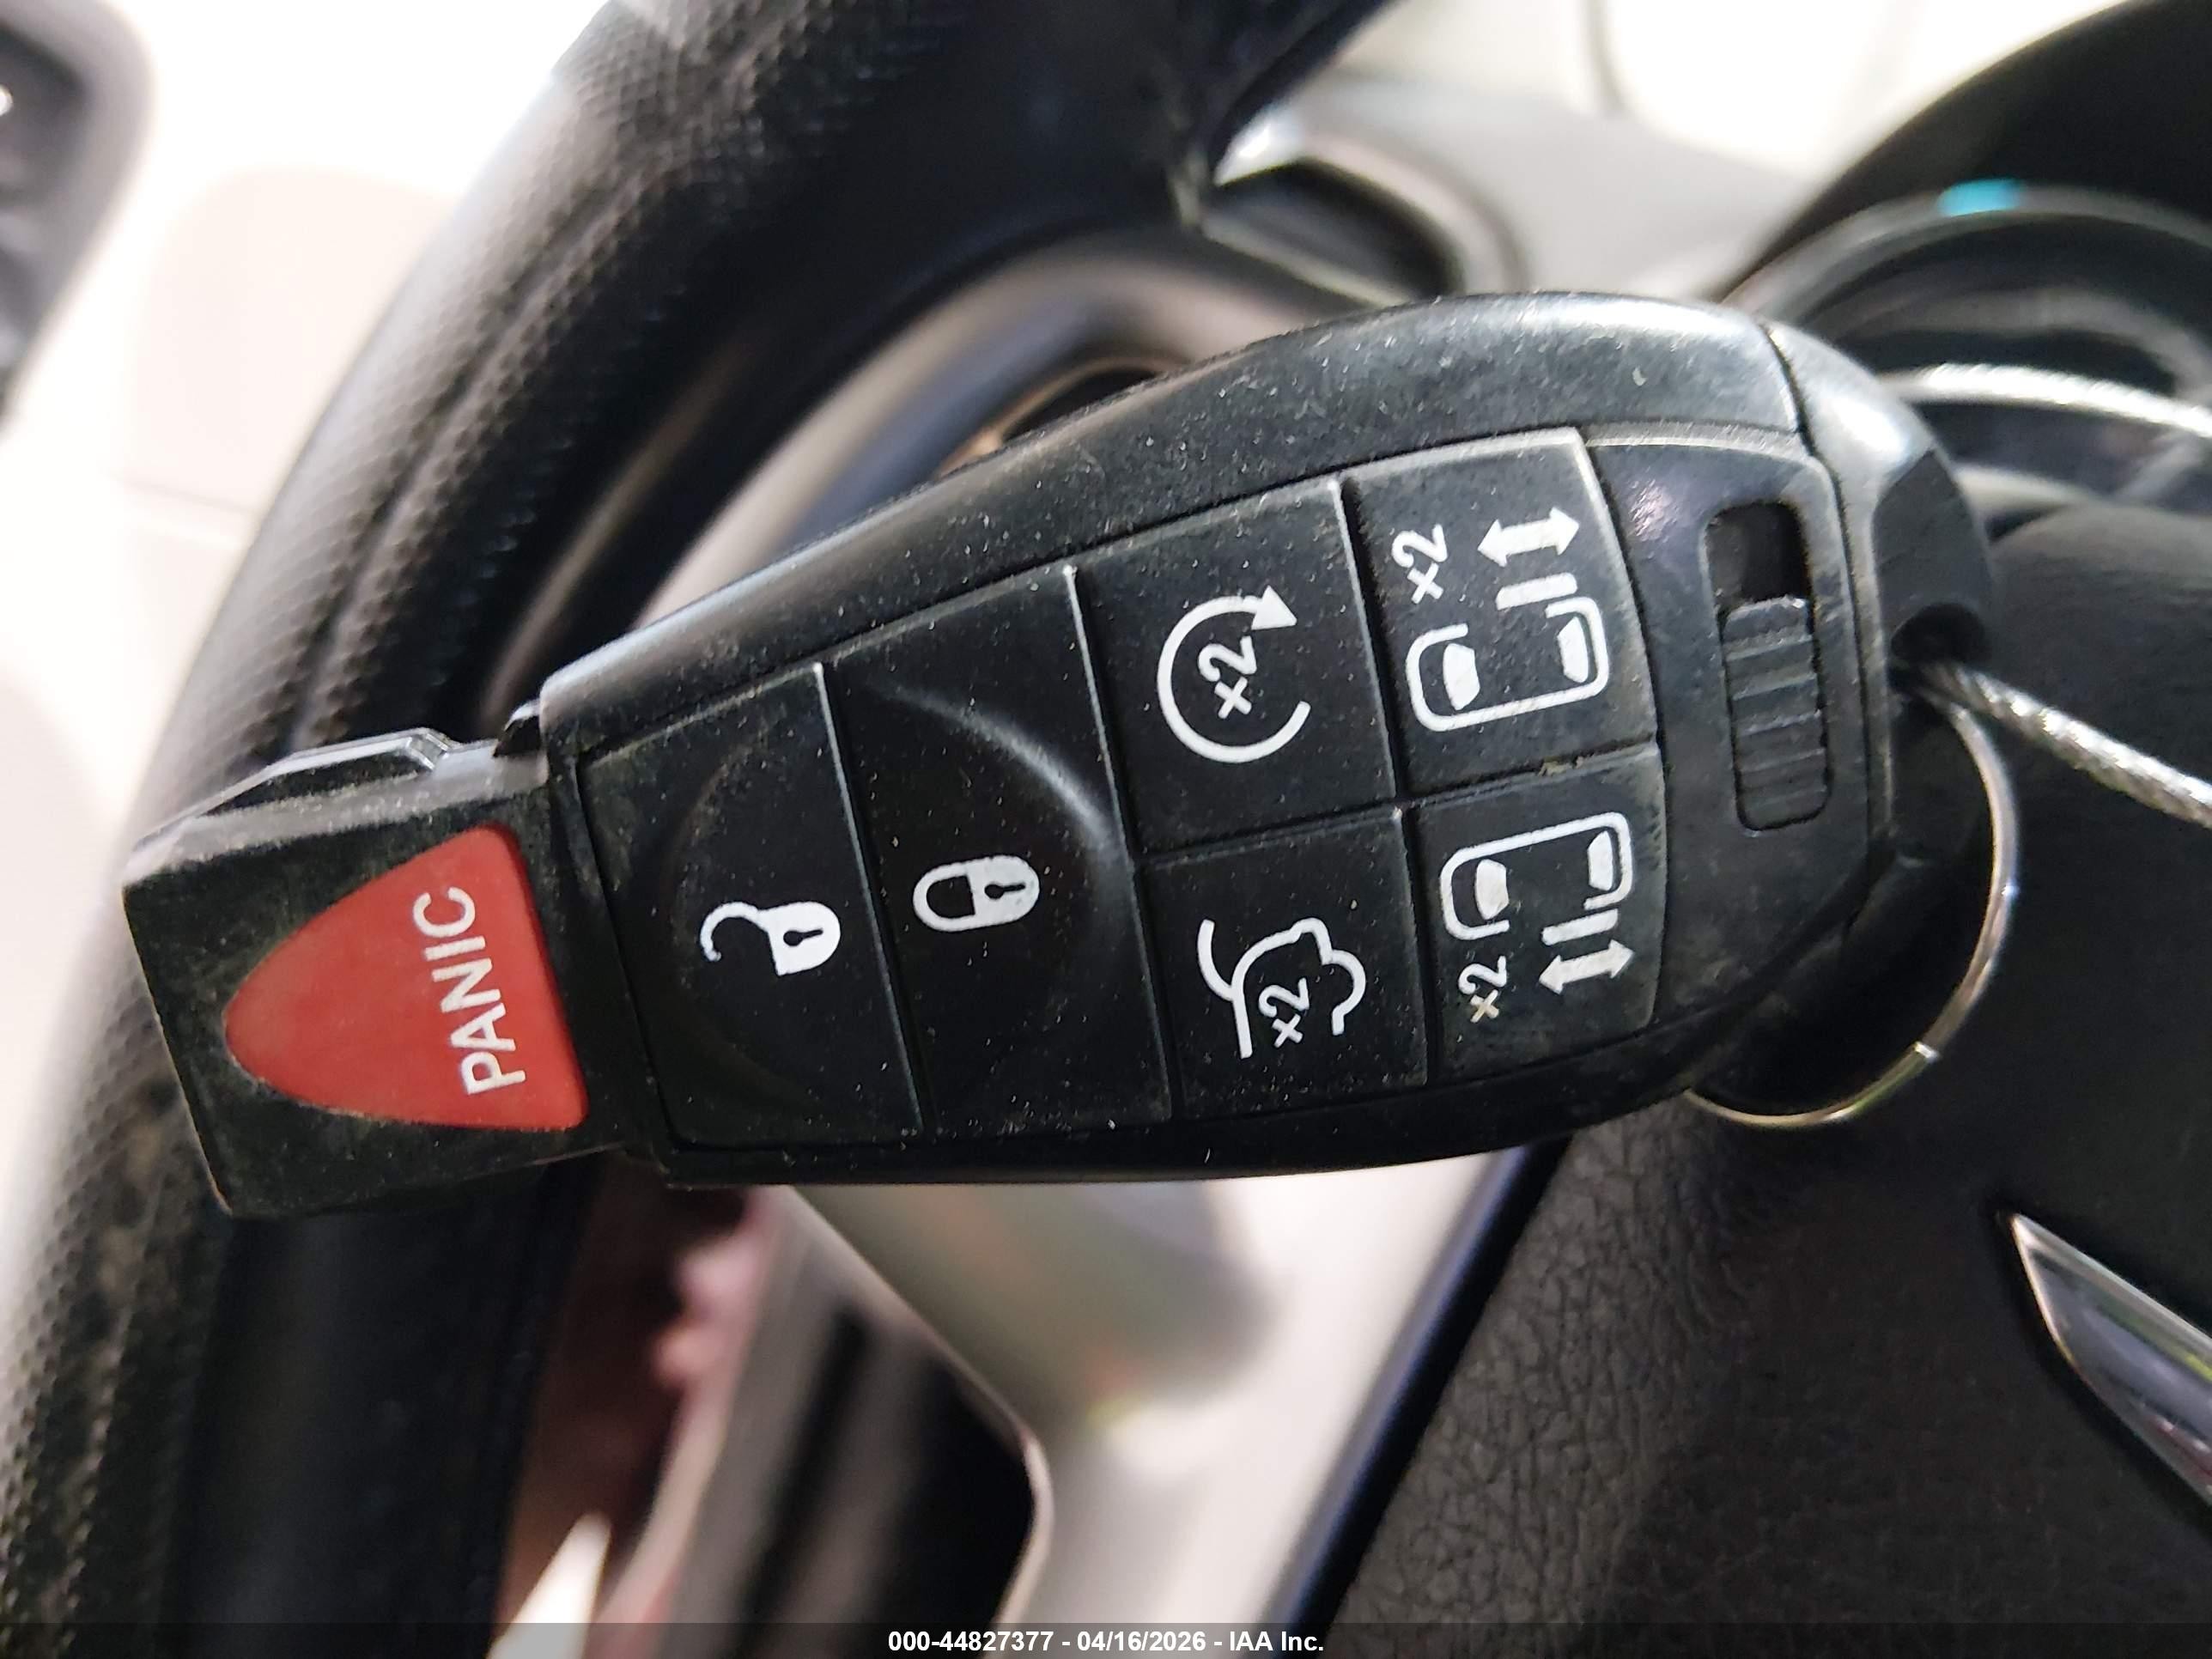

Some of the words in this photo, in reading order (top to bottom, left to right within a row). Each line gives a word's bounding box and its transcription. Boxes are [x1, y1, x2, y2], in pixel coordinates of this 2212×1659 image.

[1391, 524, 1449, 604] x2
[1198, 635, 1257, 719] x2
[413, 887, 526, 1095] PANIC
[1259, 977, 1310, 1048] x2
[1458, 956, 1508, 1023] x2
